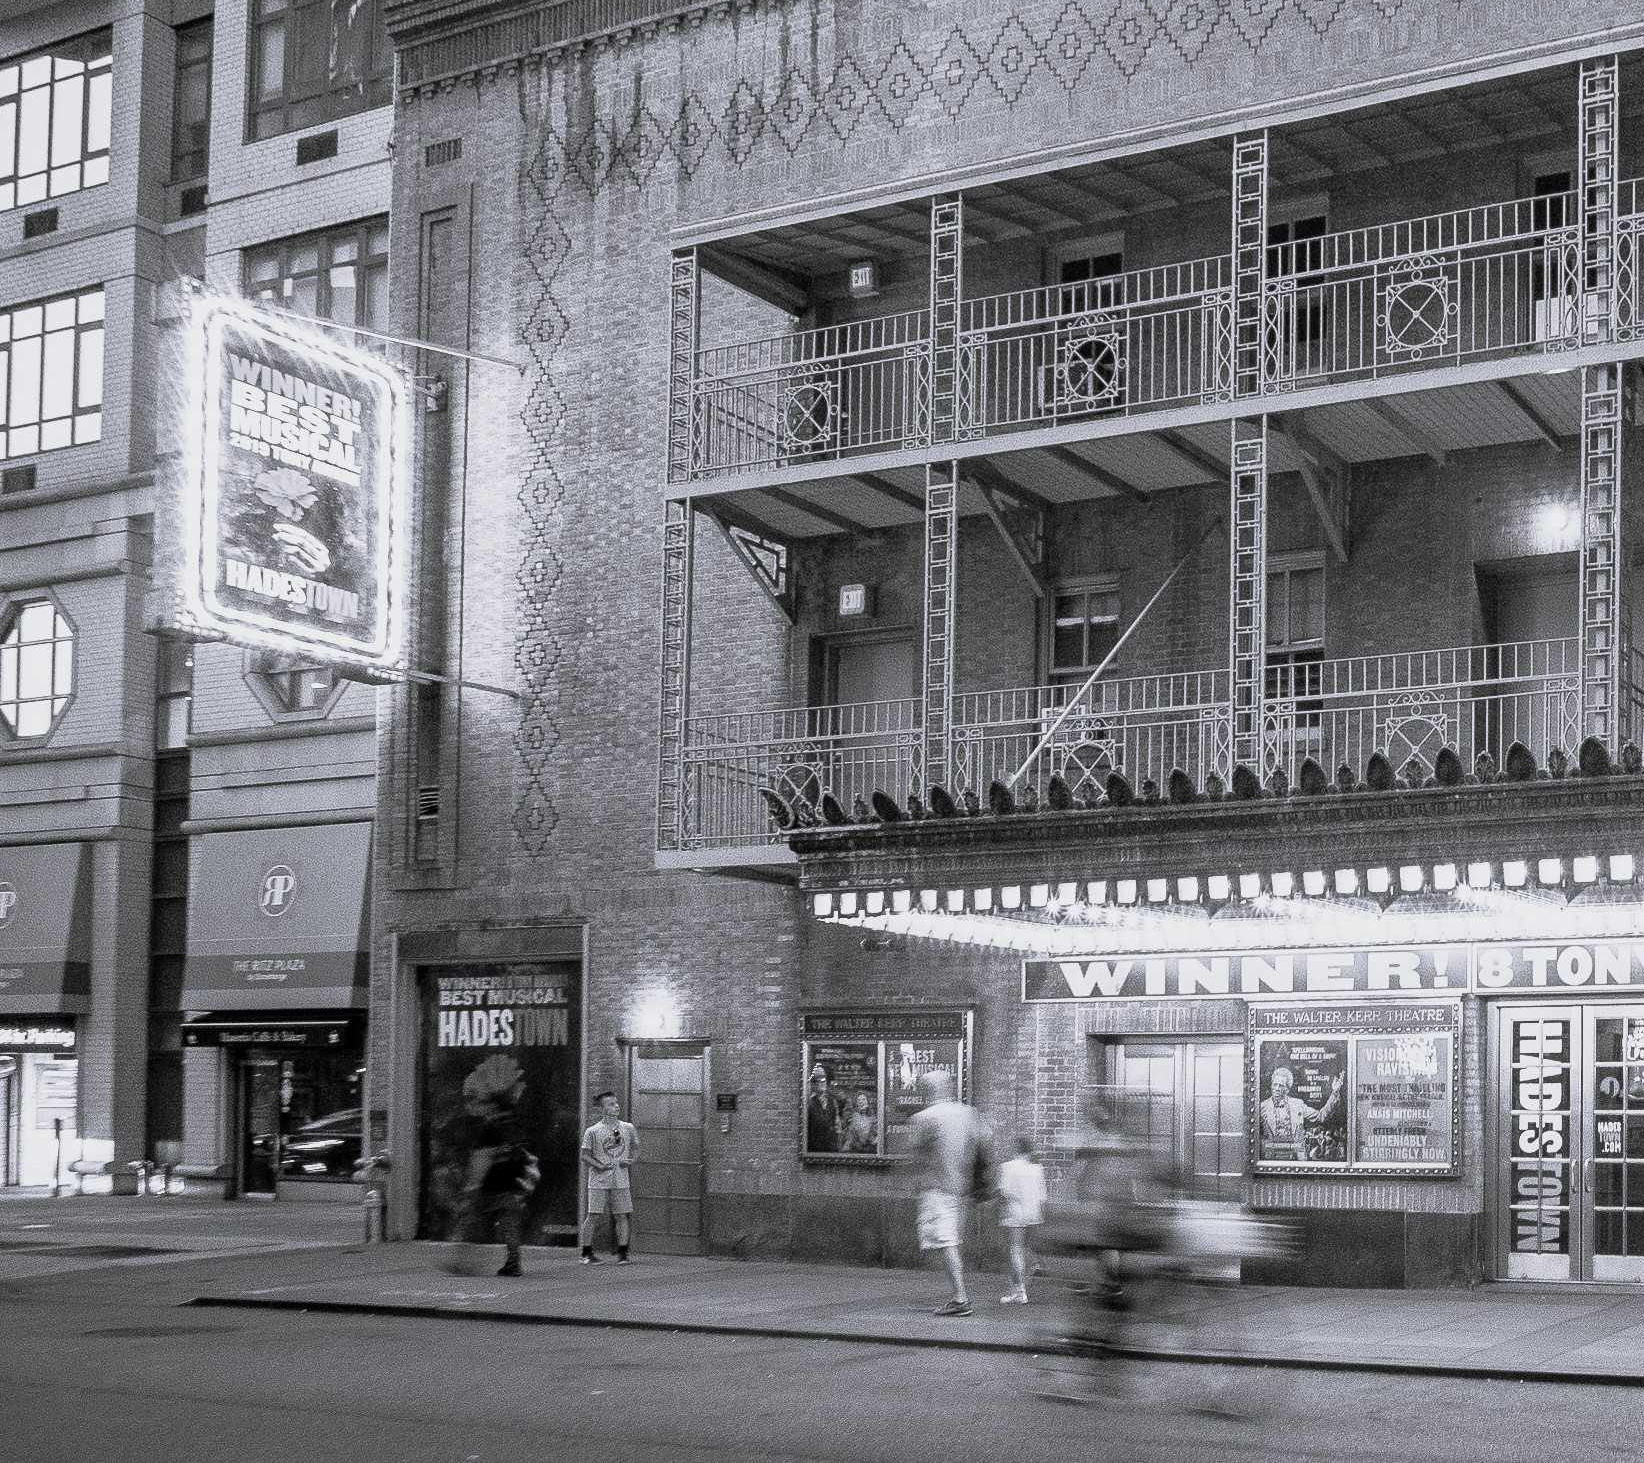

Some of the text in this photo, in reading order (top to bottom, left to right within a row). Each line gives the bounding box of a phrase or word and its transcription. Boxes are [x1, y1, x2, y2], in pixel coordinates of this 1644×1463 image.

[229, 353, 361, 425] WINNER!
[231, 378, 361, 447] BEST
[229, 403, 361, 475] MUSICAL
[226, 558, 359, 620] HADESTOWN
[1058, 951, 1450, 997] WINNER!
[1478, 948, 1513, 988] 8
[439, 988, 569, 1005] BEST MUSICAL
[438, 1009, 569, 1046] HADESTOWN
[1263, 1008, 1445, 1025] THE WALTER KERR THEATRE
[1367, 1135, 1428, 1148] UNDENIABLY
[1517, 1021, 1563, 1252] HADESTOWN
[1597, 1121, 1622, 1133] HADES
[1599, 1132, 1622, 1143] TOWN
[1362, 1148, 1420, 1161] STIRRINGLY
[1601, 1141, 1622, 1154] .COM
